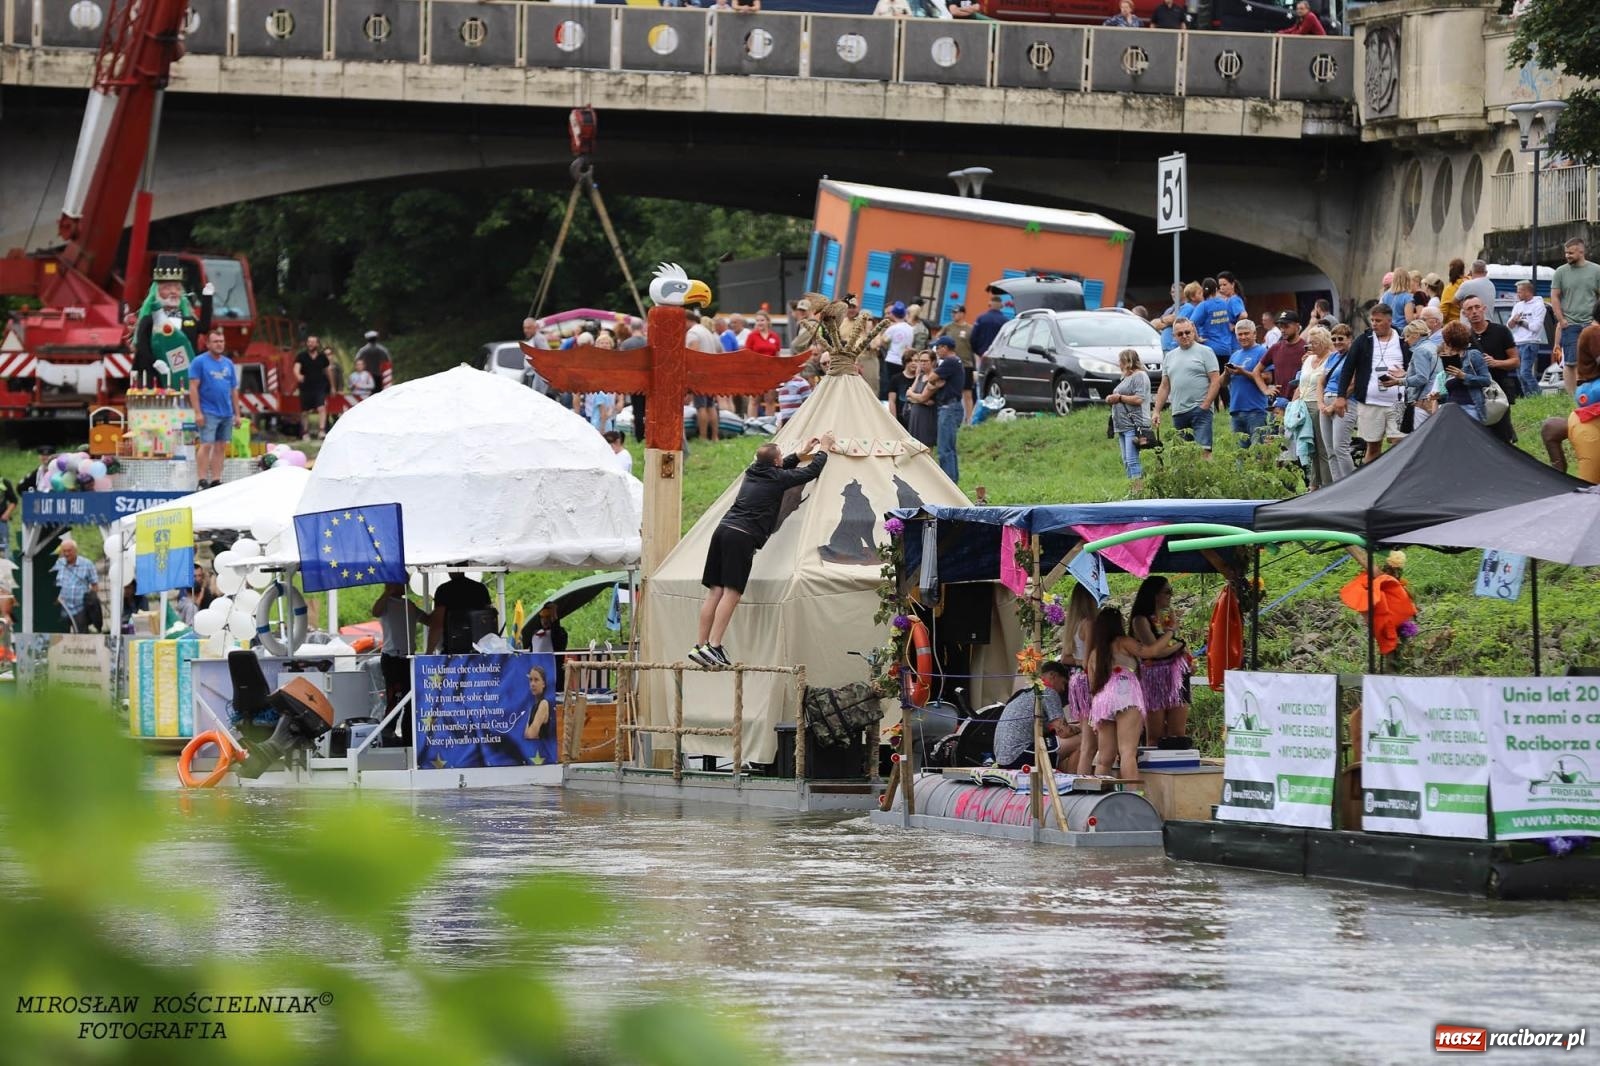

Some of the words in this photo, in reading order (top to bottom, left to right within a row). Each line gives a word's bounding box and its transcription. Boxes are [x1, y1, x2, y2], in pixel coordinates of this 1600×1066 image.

[1162, 167, 1182, 221] 51
[56, 498, 66, 514] NA
[422, 664, 436, 674] Unia
[438, 664, 456, 674] klimat
[457, 664, 471, 674] chce
[474, 677, 500, 688] zamrozić
[424, 693, 434, 706] My
[440, 695, 452, 706] tym
[452, 692, 466, 704] radę
[466, 692, 482, 702] sobie
[483, 692, 500, 703] damy
[1503, 686, 1542, 702] Unia
[1548, 686, 1571, 702] lat
[1576, 686, 1600, 702] 20
[1282, 703, 1302, 715] MYCIE
[1428, 708, 1452, 720] MYCIE
[1512, 714, 1521, 724] z
[1526, 710, 1567, 724] nami
[1571, 714, 1582, 724] o
[442, 721, 468, 732] twardszy
[468, 720, 480, 732] jest
[491, 719, 508, 728] Greta
[1282, 724, 1302, 737] MYCIE
[426, 736, 444, 746] Nasze
[481, 734, 502, 744] rakieta
[1431, 730, 1452, 743] MYCIE
[1506, 735, 1590, 752] Raciborza
[1282, 746, 1302, 758] MYCIE
[1431, 752, 1453, 765] MYCIE
[1550, 787, 1593, 798] PROFADA
